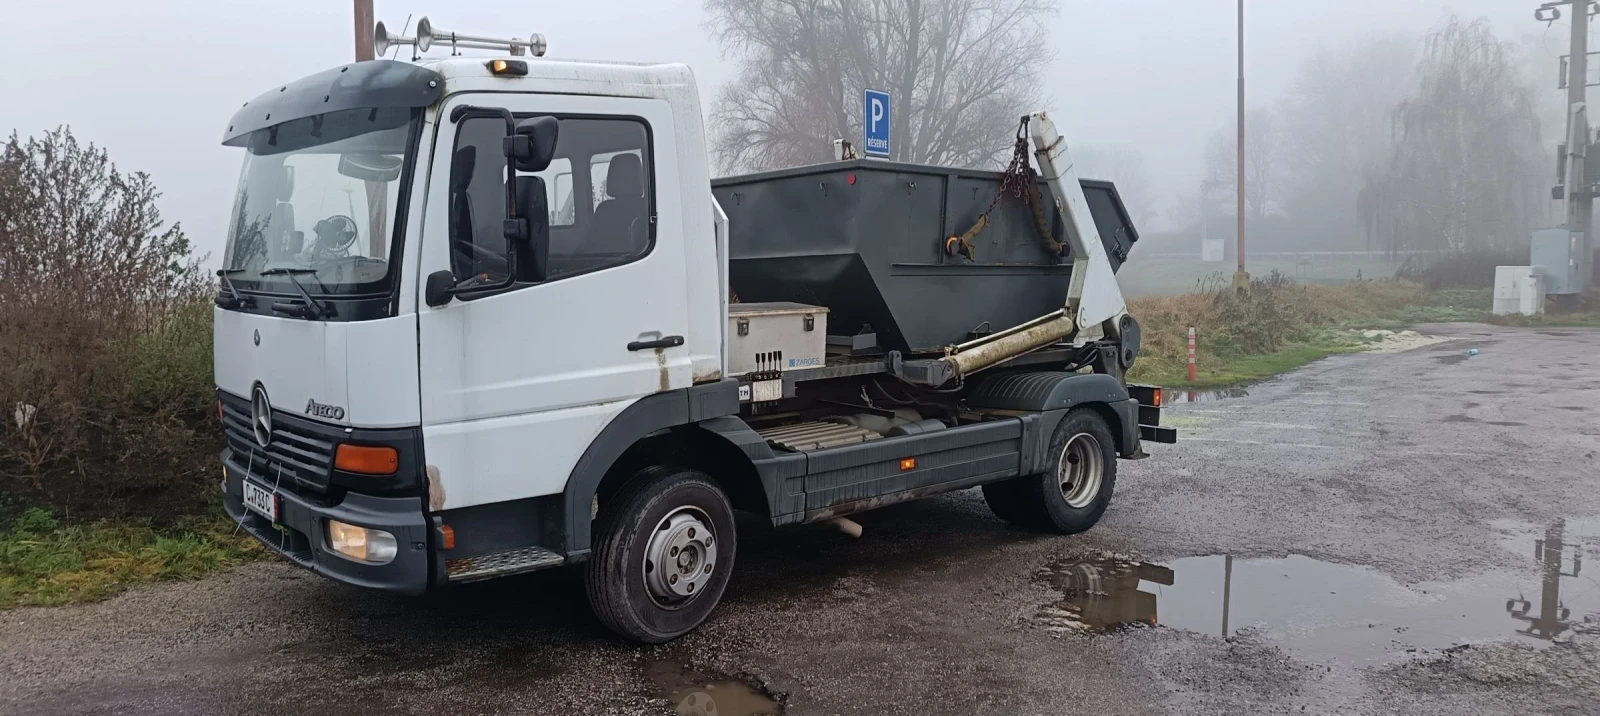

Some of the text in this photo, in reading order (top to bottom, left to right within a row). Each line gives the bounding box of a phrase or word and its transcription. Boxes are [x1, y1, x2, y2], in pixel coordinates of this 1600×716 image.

[871, 98, 883, 133] P
[868, 136, 888, 149] RÉSERVÉ
[795, 357, 820, 366] ZARGES
